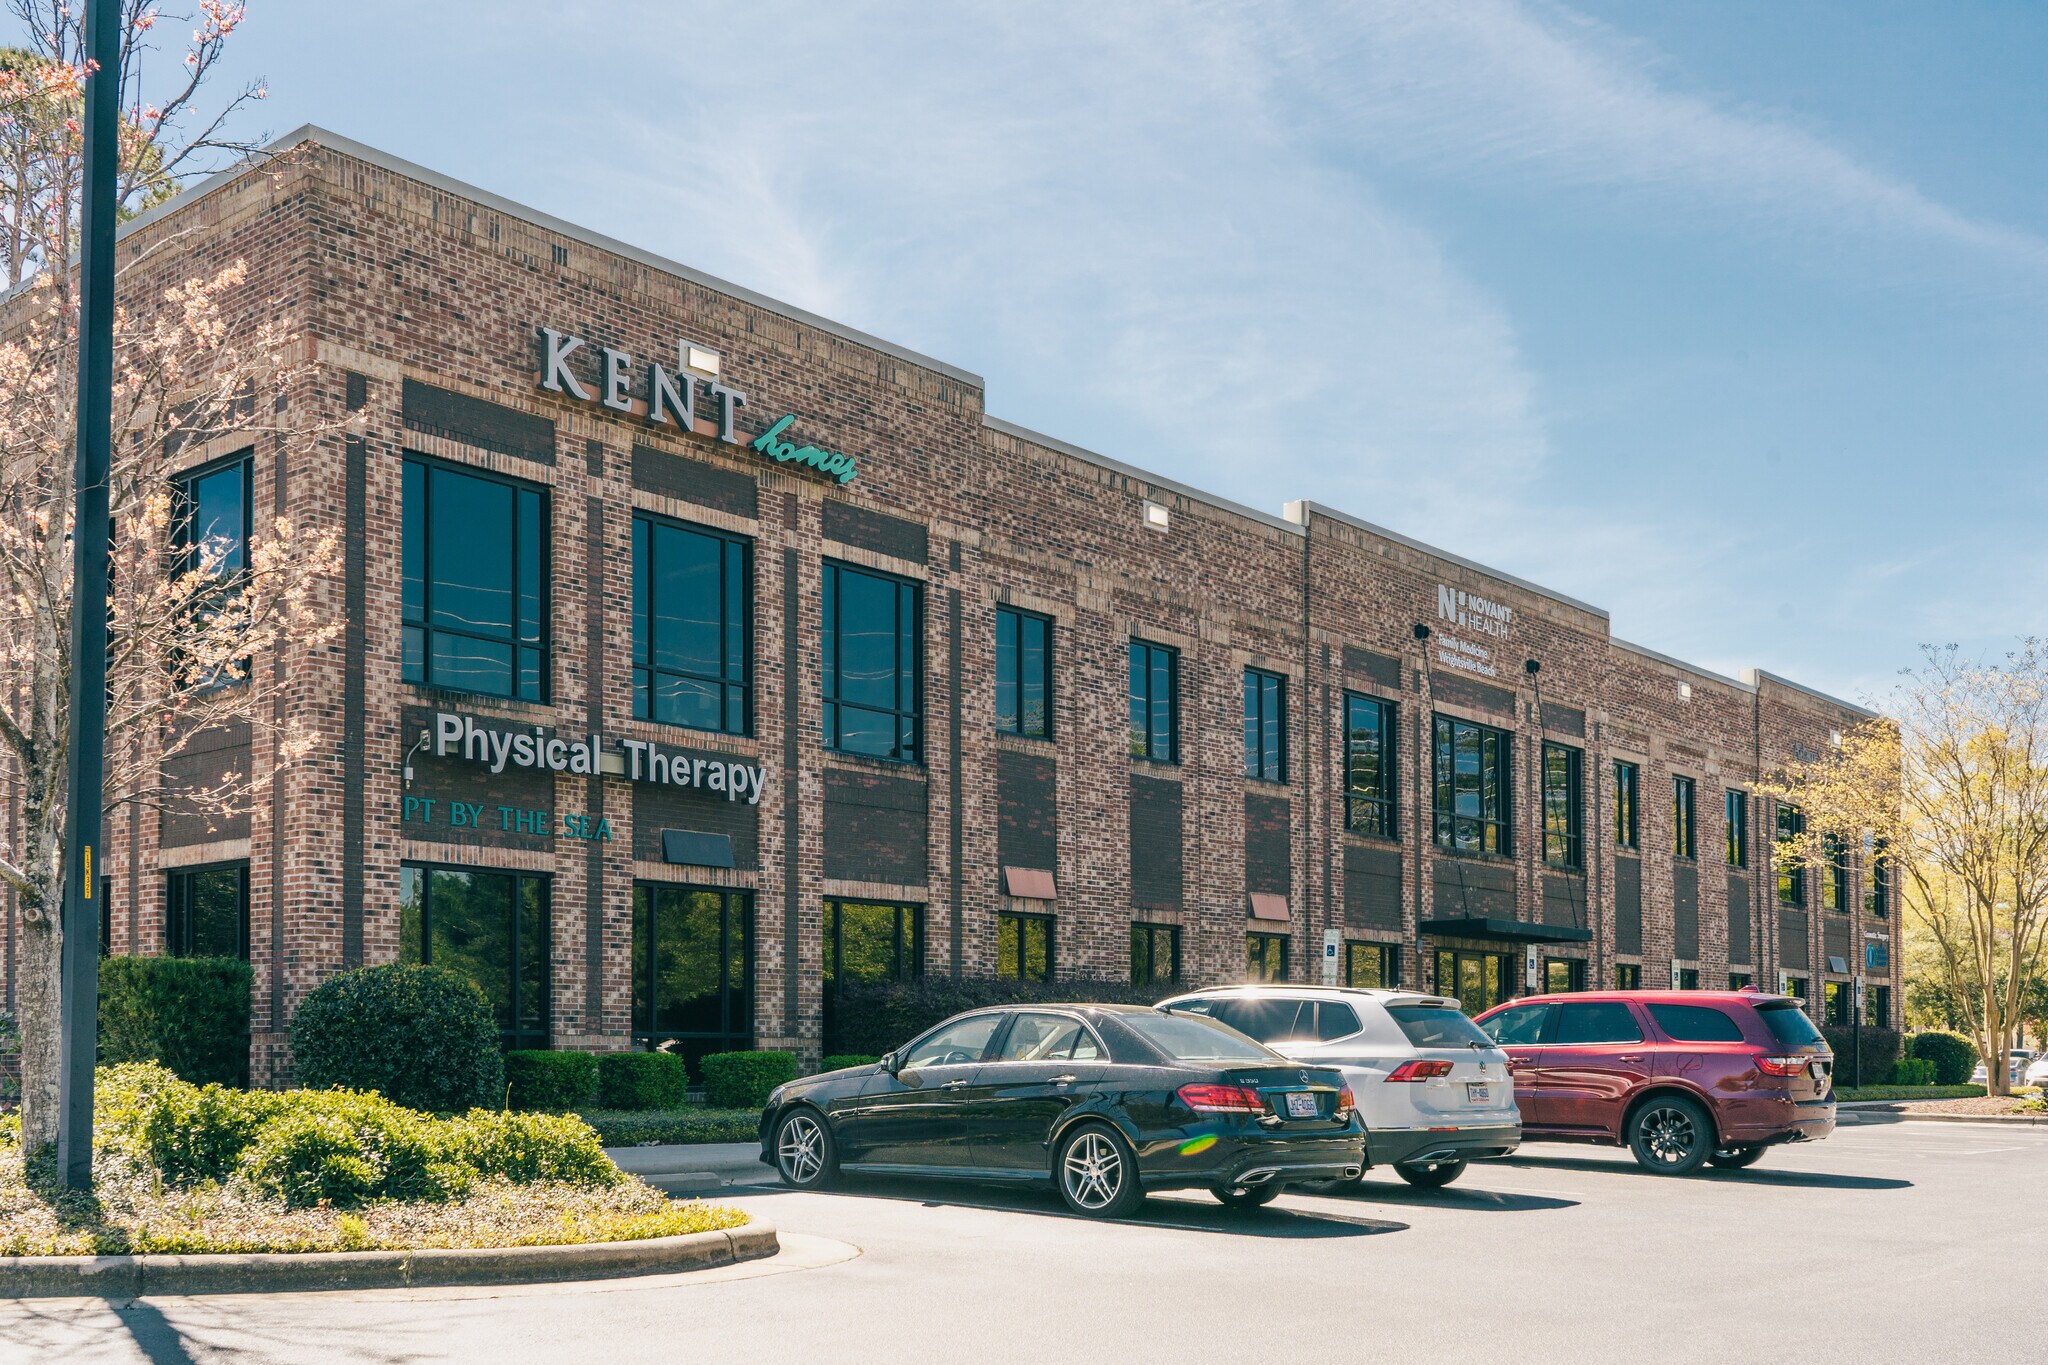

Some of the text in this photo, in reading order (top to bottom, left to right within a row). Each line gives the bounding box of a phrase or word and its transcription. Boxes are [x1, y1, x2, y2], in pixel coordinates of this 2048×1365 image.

[539, 327, 747, 445] KENT
[752, 413, 858, 484] homes
[1468, 594, 1512, 623] NOVANT
[1468, 612, 1508, 640] HEALTH
[1438, 633, 1488, 659] Family Medicine
[1438, 650, 1496, 677] Wrightsville Beach
[436, 712, 766, 805] Physical Therapy
[403, 796, 613, 842] PT BY THE SEA
